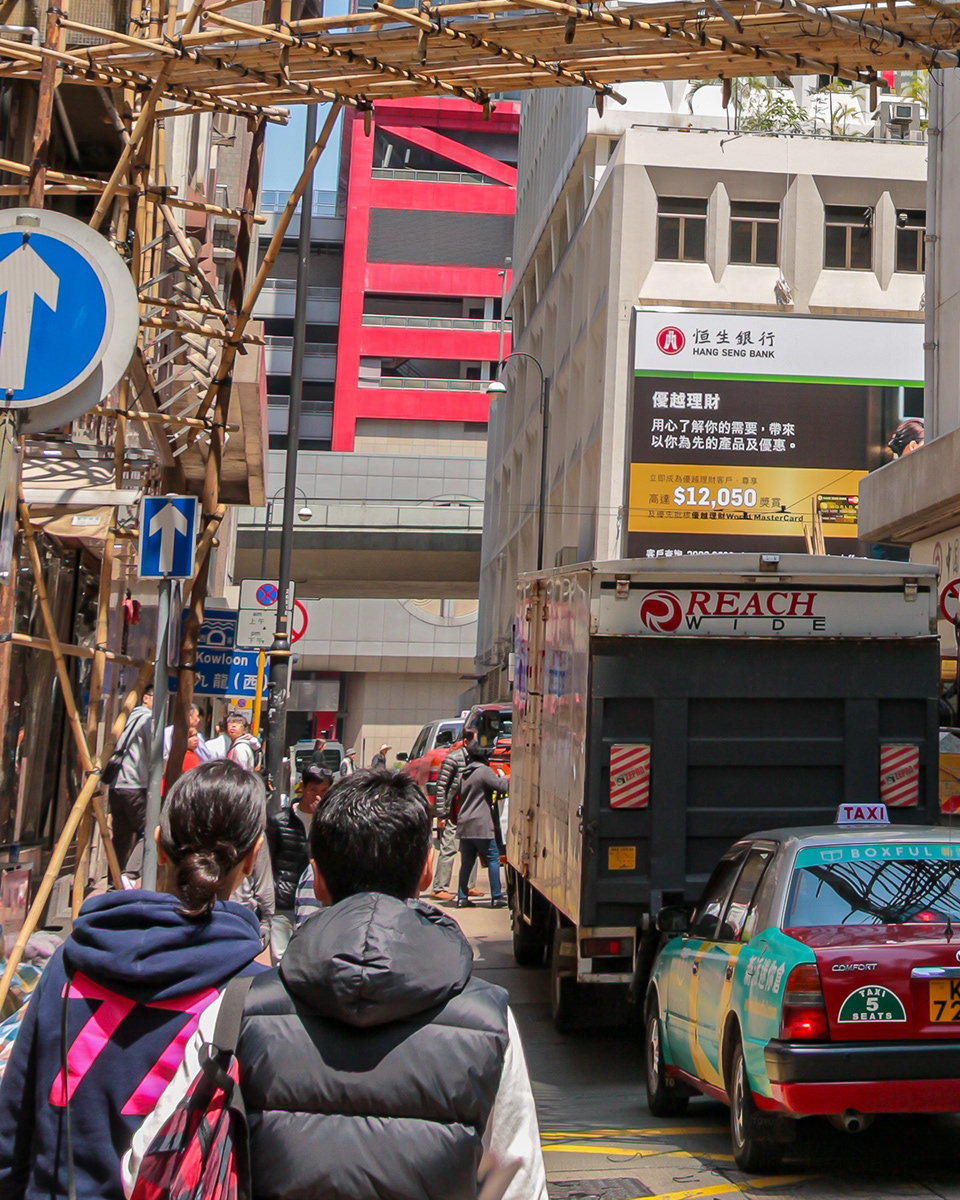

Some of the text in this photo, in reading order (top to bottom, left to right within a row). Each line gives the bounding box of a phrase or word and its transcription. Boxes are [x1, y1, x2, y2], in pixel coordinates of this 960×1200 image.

[693, 328, 776, 347] 恒生銀行
[693, 348, 775, 358] HANG SENG BANK
[652, 390, 721, 410] 優越理財
[648, 493, 670, 505] 高達
[673, 486, 757, 509] $12,050
[754, 513, 804, 522] MasterCard
[686, 591, 818, 616] REACH
[196, 651, 248, 666] Kowloon
[843, 806, 885, 820] TAXI
[851, 846, 933, 858] BOXFUL
[832, 963, 878, 972] COMFORT
[859, 989, 887, 998] TAXI
[866, 998, 879, 1012] 5
[852, 1012, 893, 1020] SEATS
